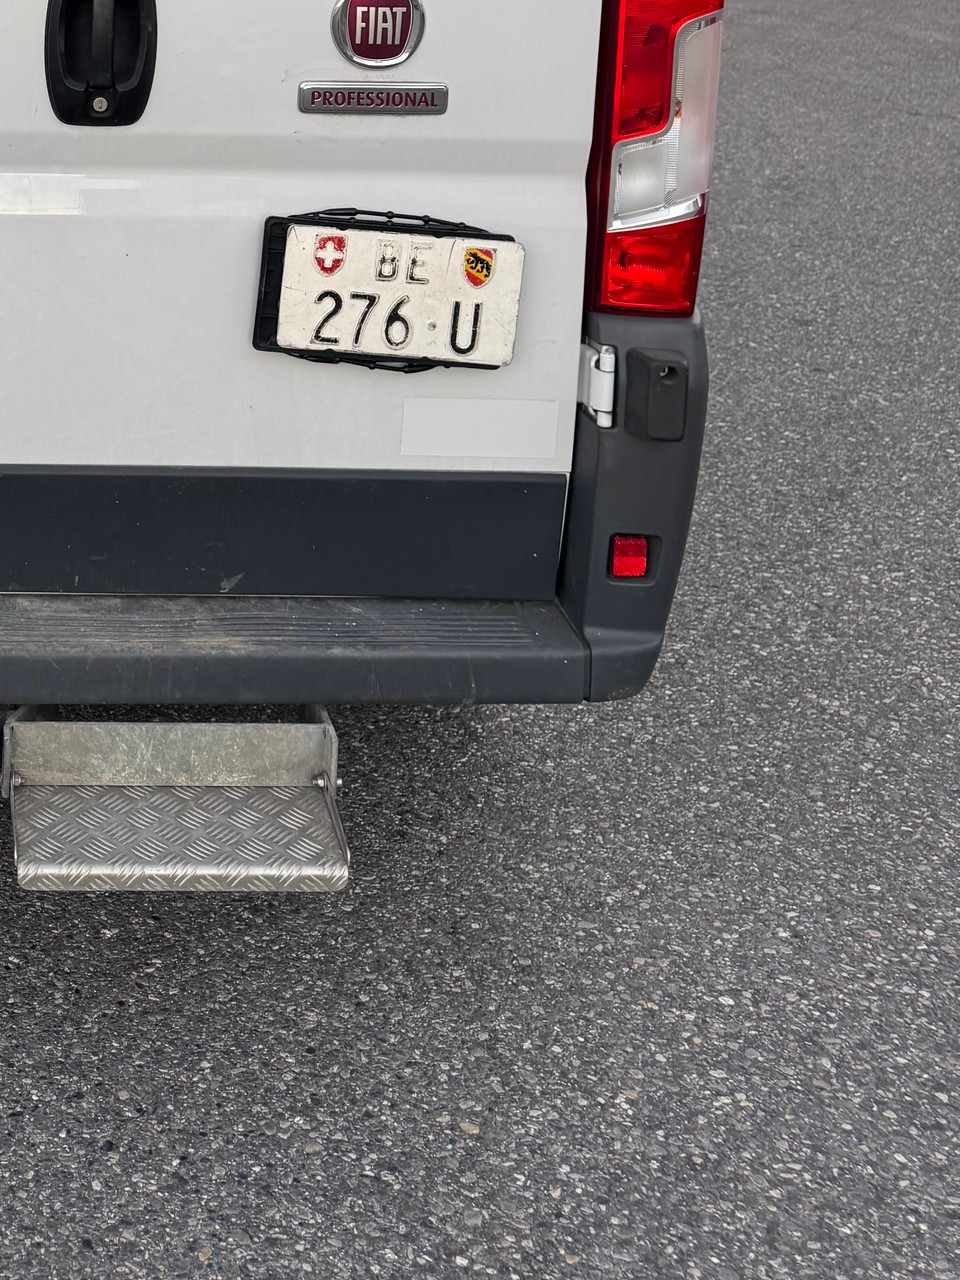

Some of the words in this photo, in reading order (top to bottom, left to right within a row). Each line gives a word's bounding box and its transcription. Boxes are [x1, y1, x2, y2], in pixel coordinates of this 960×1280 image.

[355, 6, 407, 45] FIAT
[310, 90, 438, 108] PROFESSIONAL
[375, 238, 434, 285] BE
[310, 288, 414, 351] 276
[449, 299, 483, 357] U
